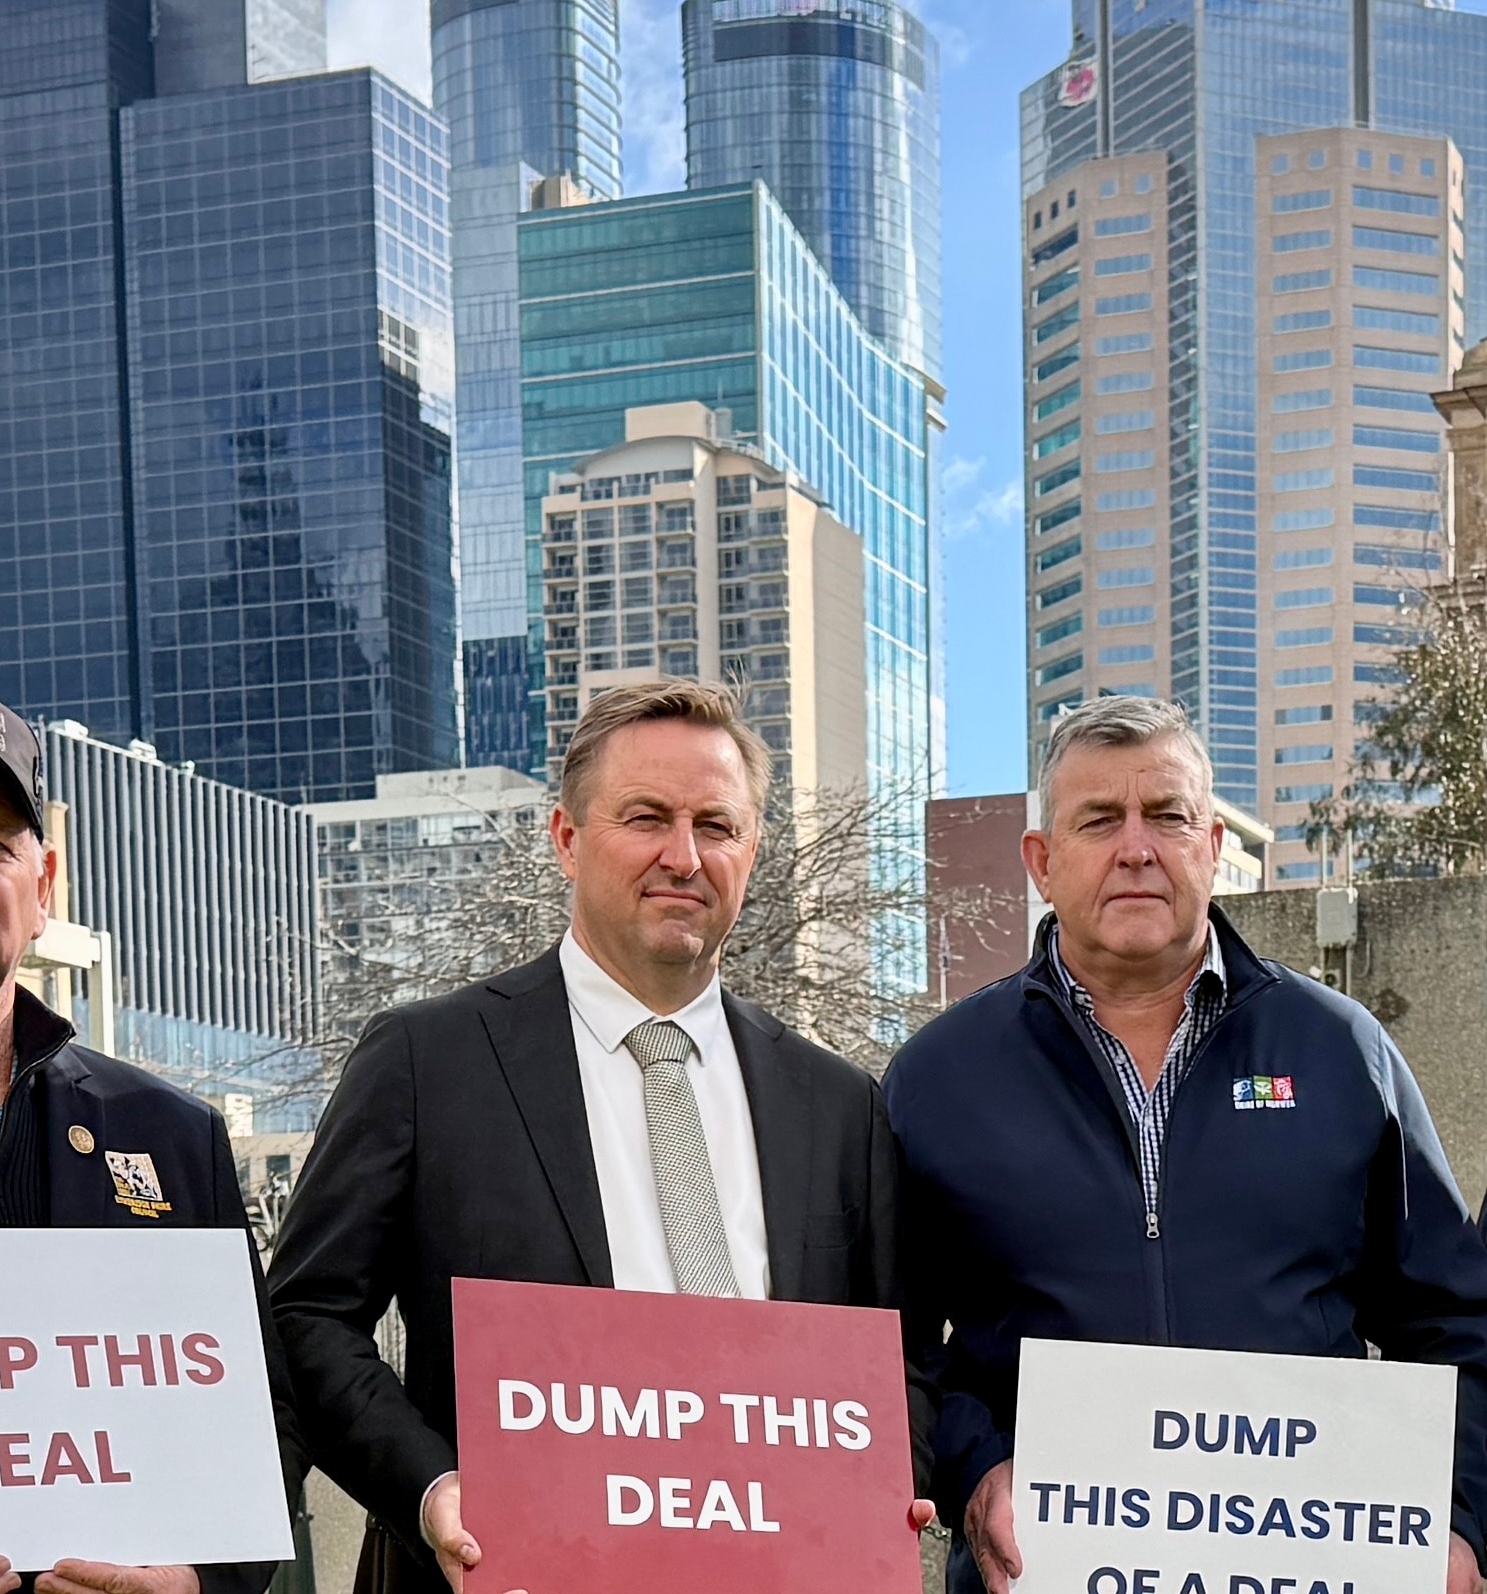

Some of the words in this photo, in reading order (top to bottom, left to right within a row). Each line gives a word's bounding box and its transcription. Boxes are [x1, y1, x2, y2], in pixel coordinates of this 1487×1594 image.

[56, 1333, 224, 1387] THIS
[499, 1380, 704, 1440] DUMP
[720, 1394, 871, 1449] THIS
[1154, 1410, 1316, 1457] DUMP
[607, 1475, 780, 1531] DEAL
[1030, 1483, 1150, 1528] THIS
[1168, 1491, 1431, 1546] DISASTER
